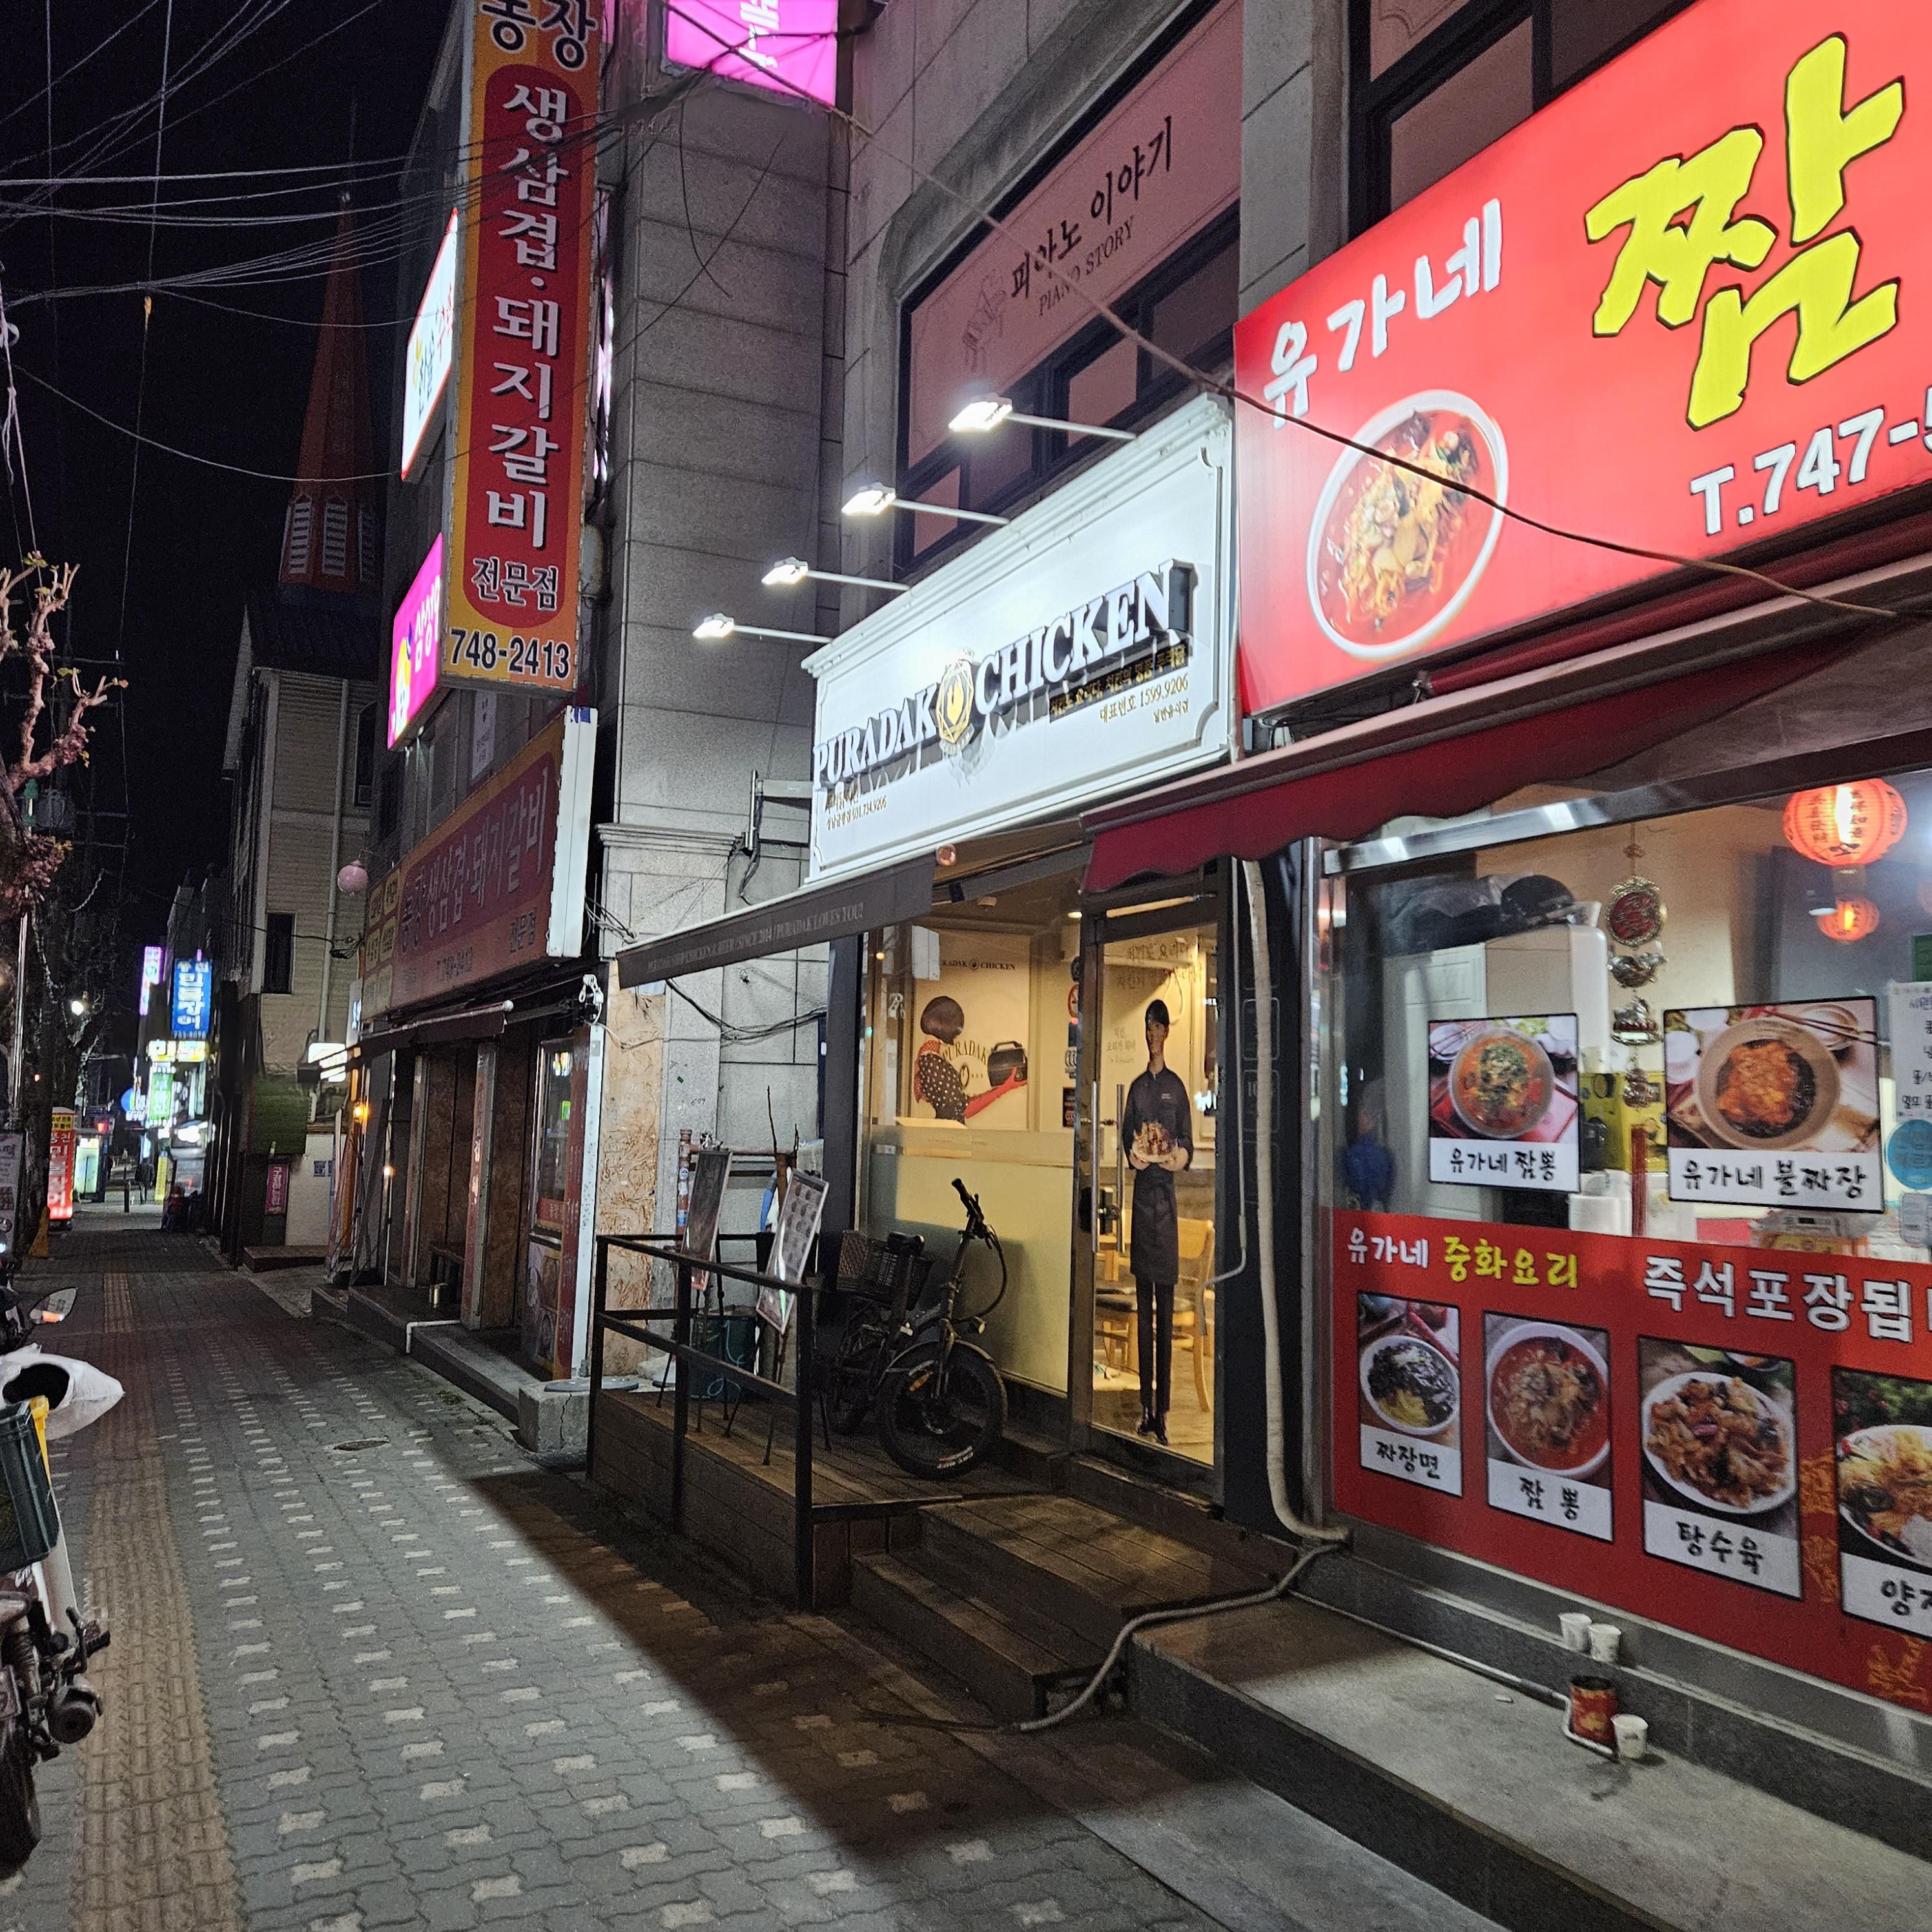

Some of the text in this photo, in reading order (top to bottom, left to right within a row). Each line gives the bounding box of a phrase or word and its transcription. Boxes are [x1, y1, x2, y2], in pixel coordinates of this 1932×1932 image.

[1011, 115, 1173, 299] 피아노 이야기
[1085, 214, 1135, 278] STORY
[1264, 198, 1502, 430] 유가네
[1689, 387, 1932, 537] T.747-
[471, 556, 559, 611] 전문점
[451, 626, 571, 681] 748-2413
[814, 558, 1199, 792] PURADAK CHICKEN
[1100, 672, 1189, 724] 대표번호 1599.9206
[980, 961, 1016, 971] CHICKEN
[1449, 1147, 1556, 1182] 유가네 짬뽕
[1681, 1160, 1868, 1202] 유가네 불짜장
[1347, 1228, 1579, 1289] 유가네 중화요리
[1643, 1255, 1932, 1344] 즉석포장됩
[1375, 1440, 1441, 1481] 짜장면
[1676, 1520, 1764, 1576] 탕수육
